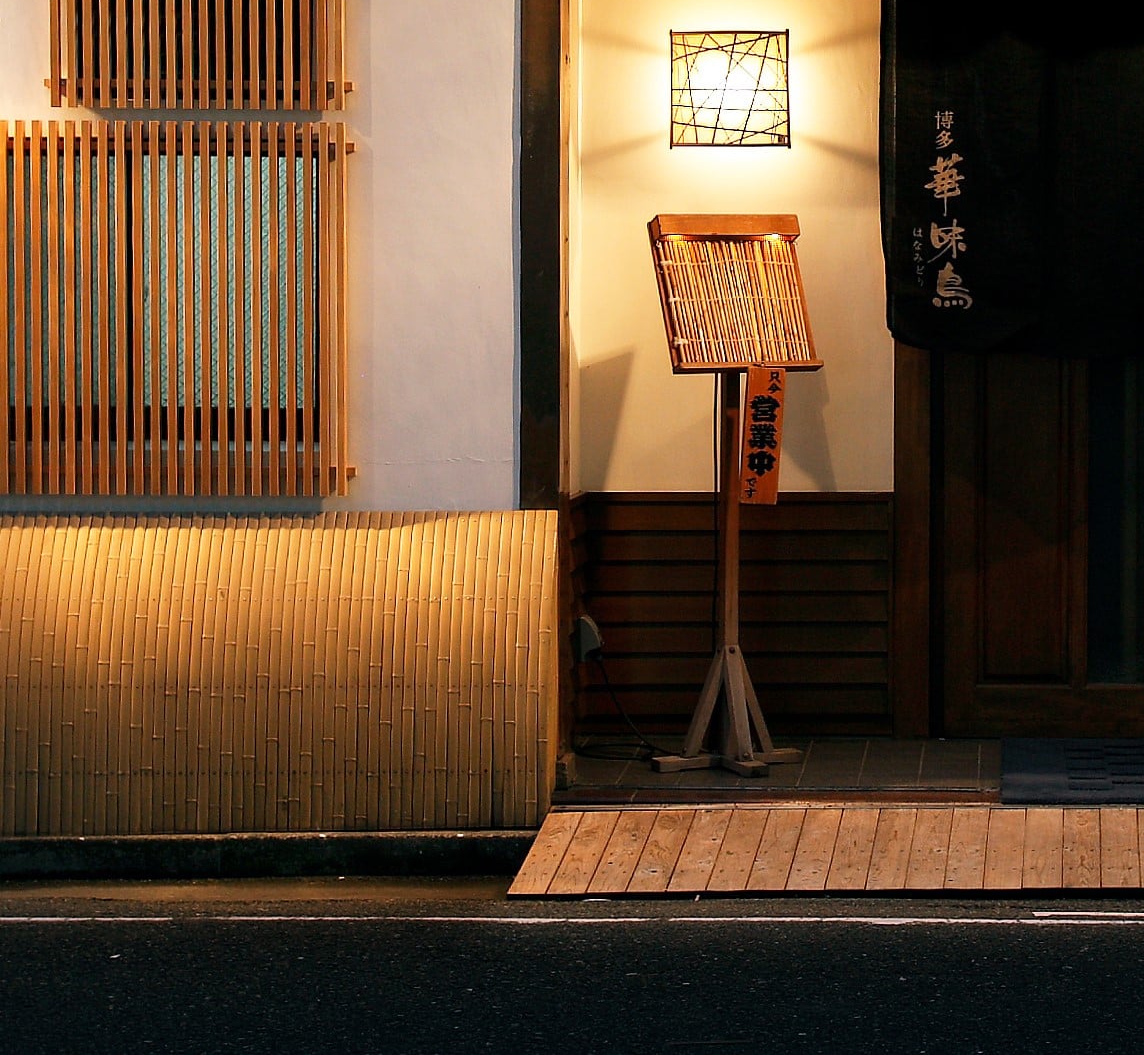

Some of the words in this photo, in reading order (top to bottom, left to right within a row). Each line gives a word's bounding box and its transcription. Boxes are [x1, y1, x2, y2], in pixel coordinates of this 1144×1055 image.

[934, 109, 955, 150] 博多
[923, 152, 974, 310] 華味鳥
[767, 370, 782, 394] 只今
[746, 394, 781, 477] 営業中
[744, 476, 758, 499] です
